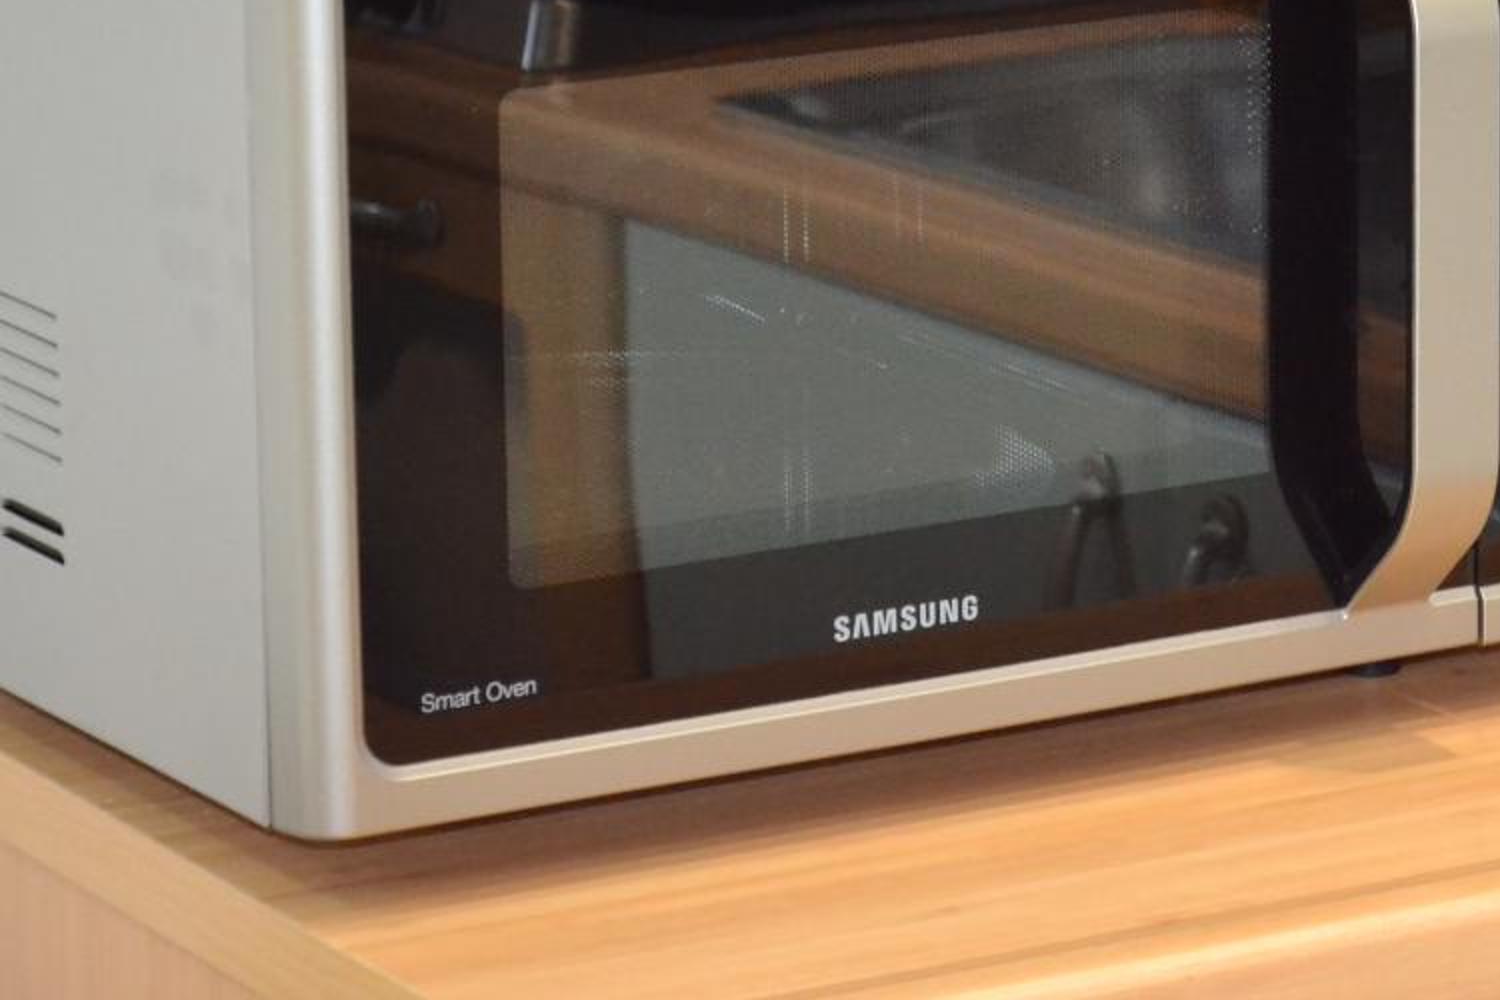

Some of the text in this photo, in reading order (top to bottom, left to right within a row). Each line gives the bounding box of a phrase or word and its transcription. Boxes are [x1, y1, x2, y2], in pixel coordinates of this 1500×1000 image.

[833, 595, 978, 643] SAMSUNG
[421, 680, 537, 713] Smart Oven
